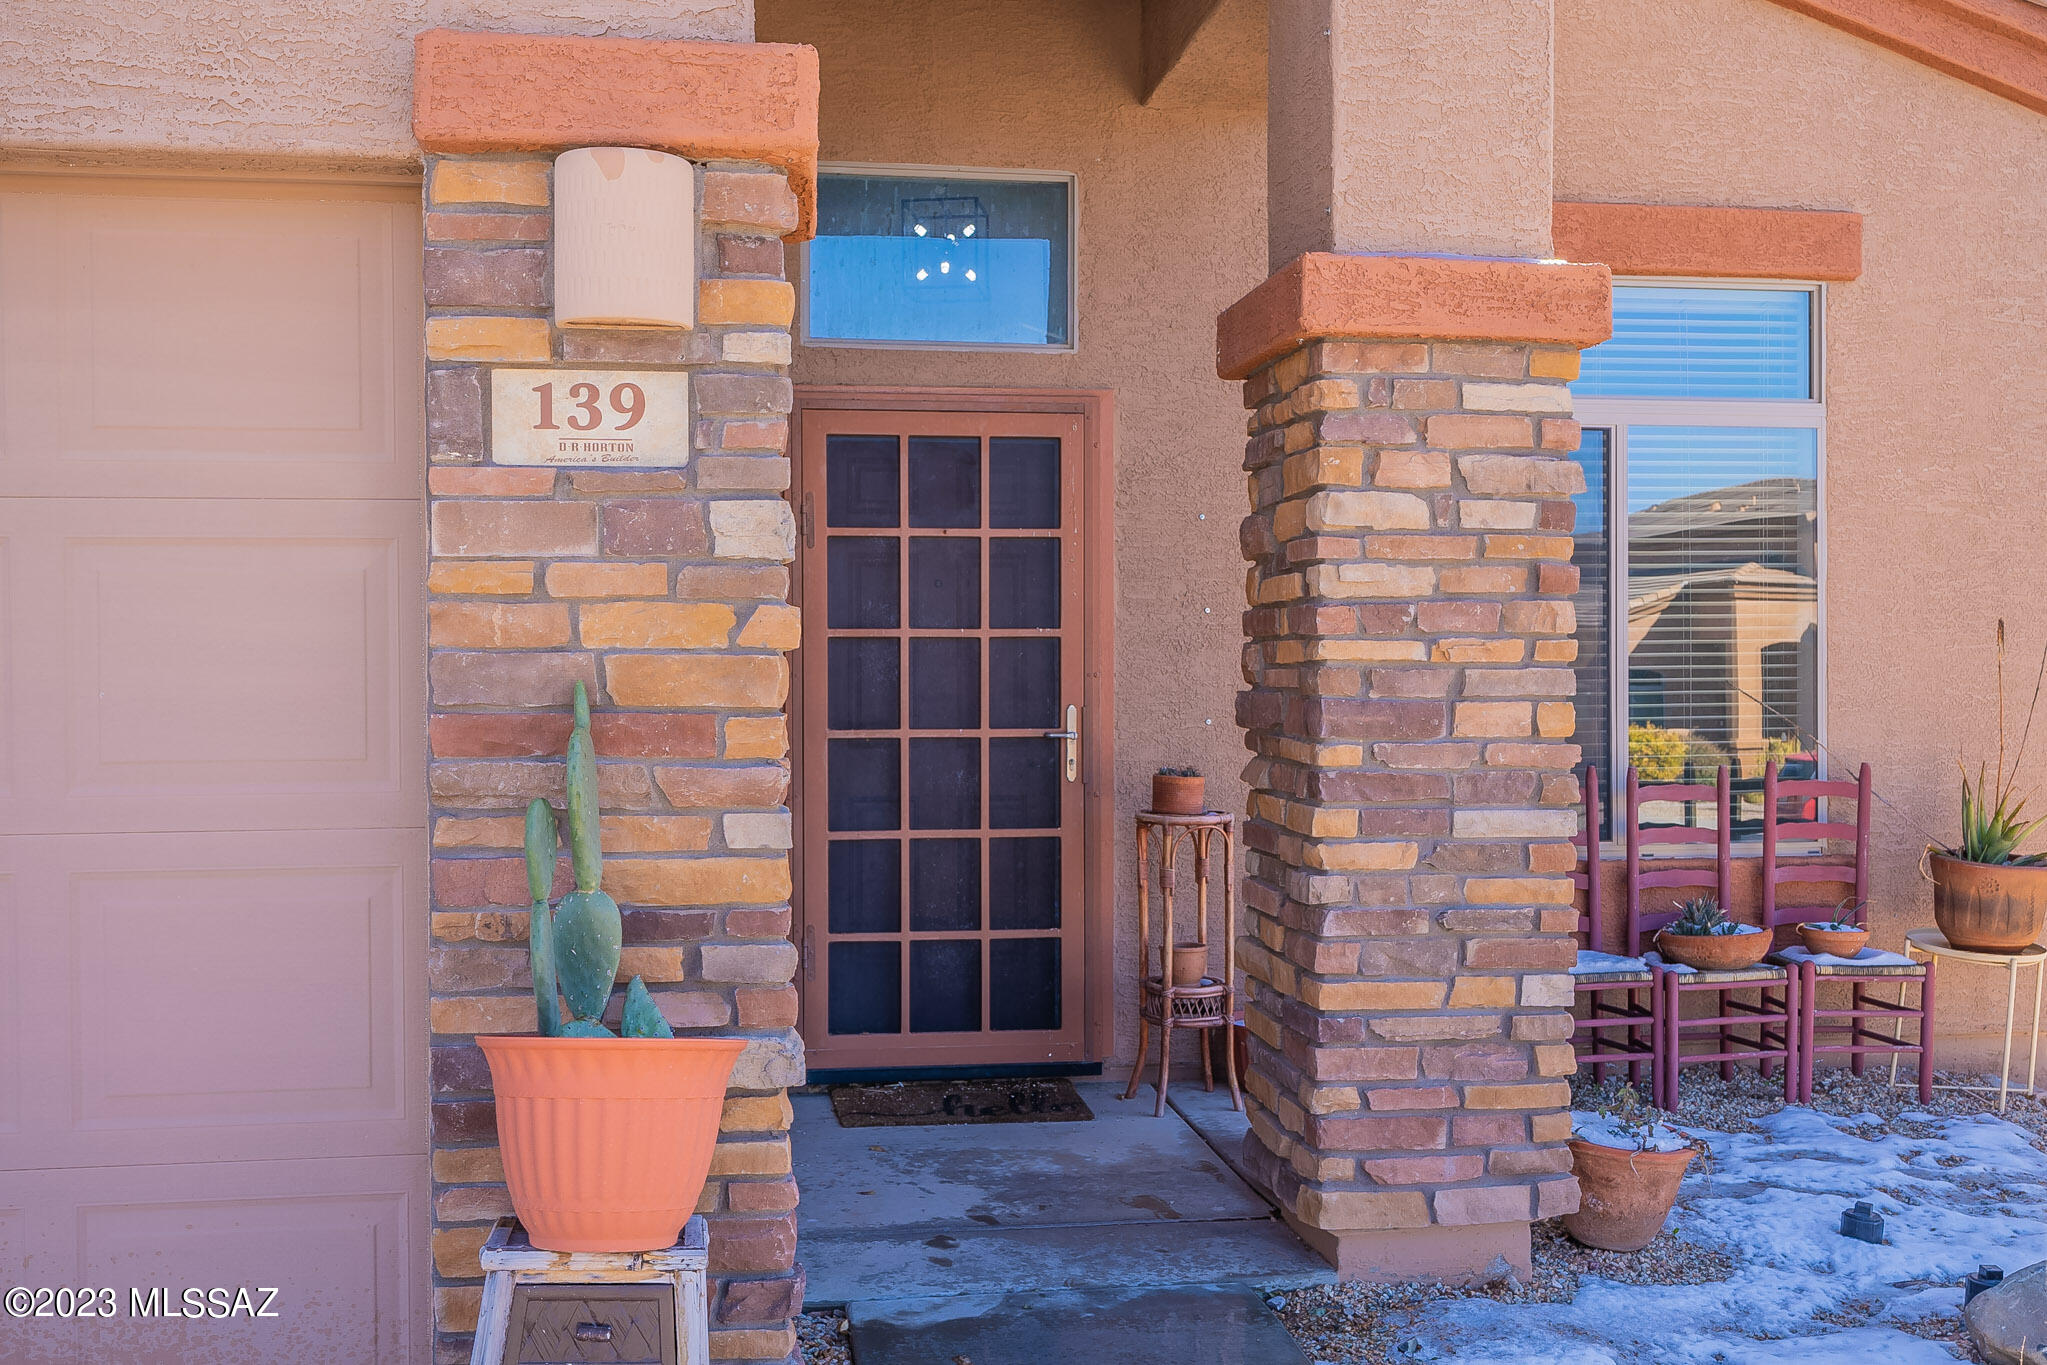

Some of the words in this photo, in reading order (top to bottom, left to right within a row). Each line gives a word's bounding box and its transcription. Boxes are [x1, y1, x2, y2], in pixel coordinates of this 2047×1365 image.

[531, 382, 646, 431] 139
[544, 454, 597, 463] America's
[601, 453, 640, 463] Builder
